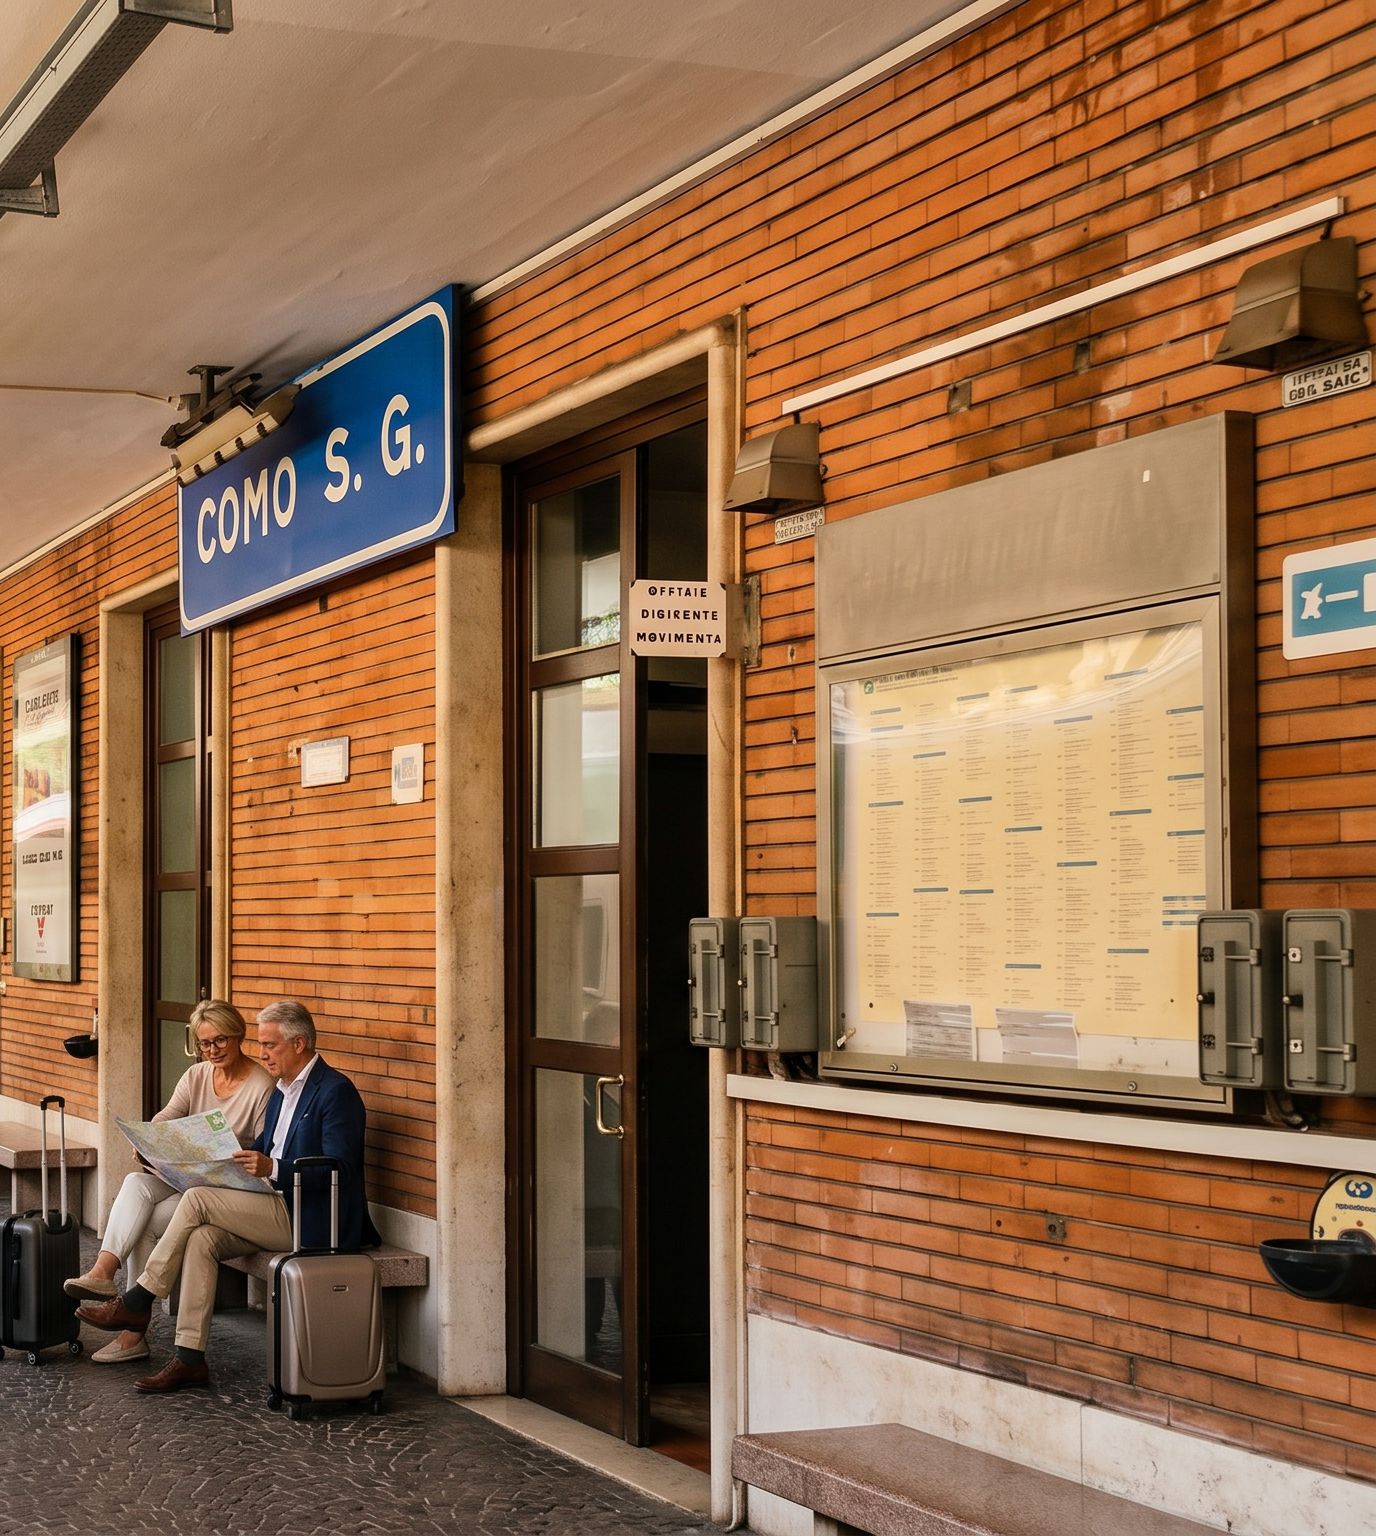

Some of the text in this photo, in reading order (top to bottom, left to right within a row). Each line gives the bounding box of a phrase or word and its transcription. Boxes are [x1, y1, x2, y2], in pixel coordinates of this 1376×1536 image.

[196, 393, 425, 564] COMO S. G.
[648, 586, 707, 598] OFFTAIE
[641, 609, 718, 621] DIGIRENTE
[636, 632, 721, 644] MOVIMENTA
